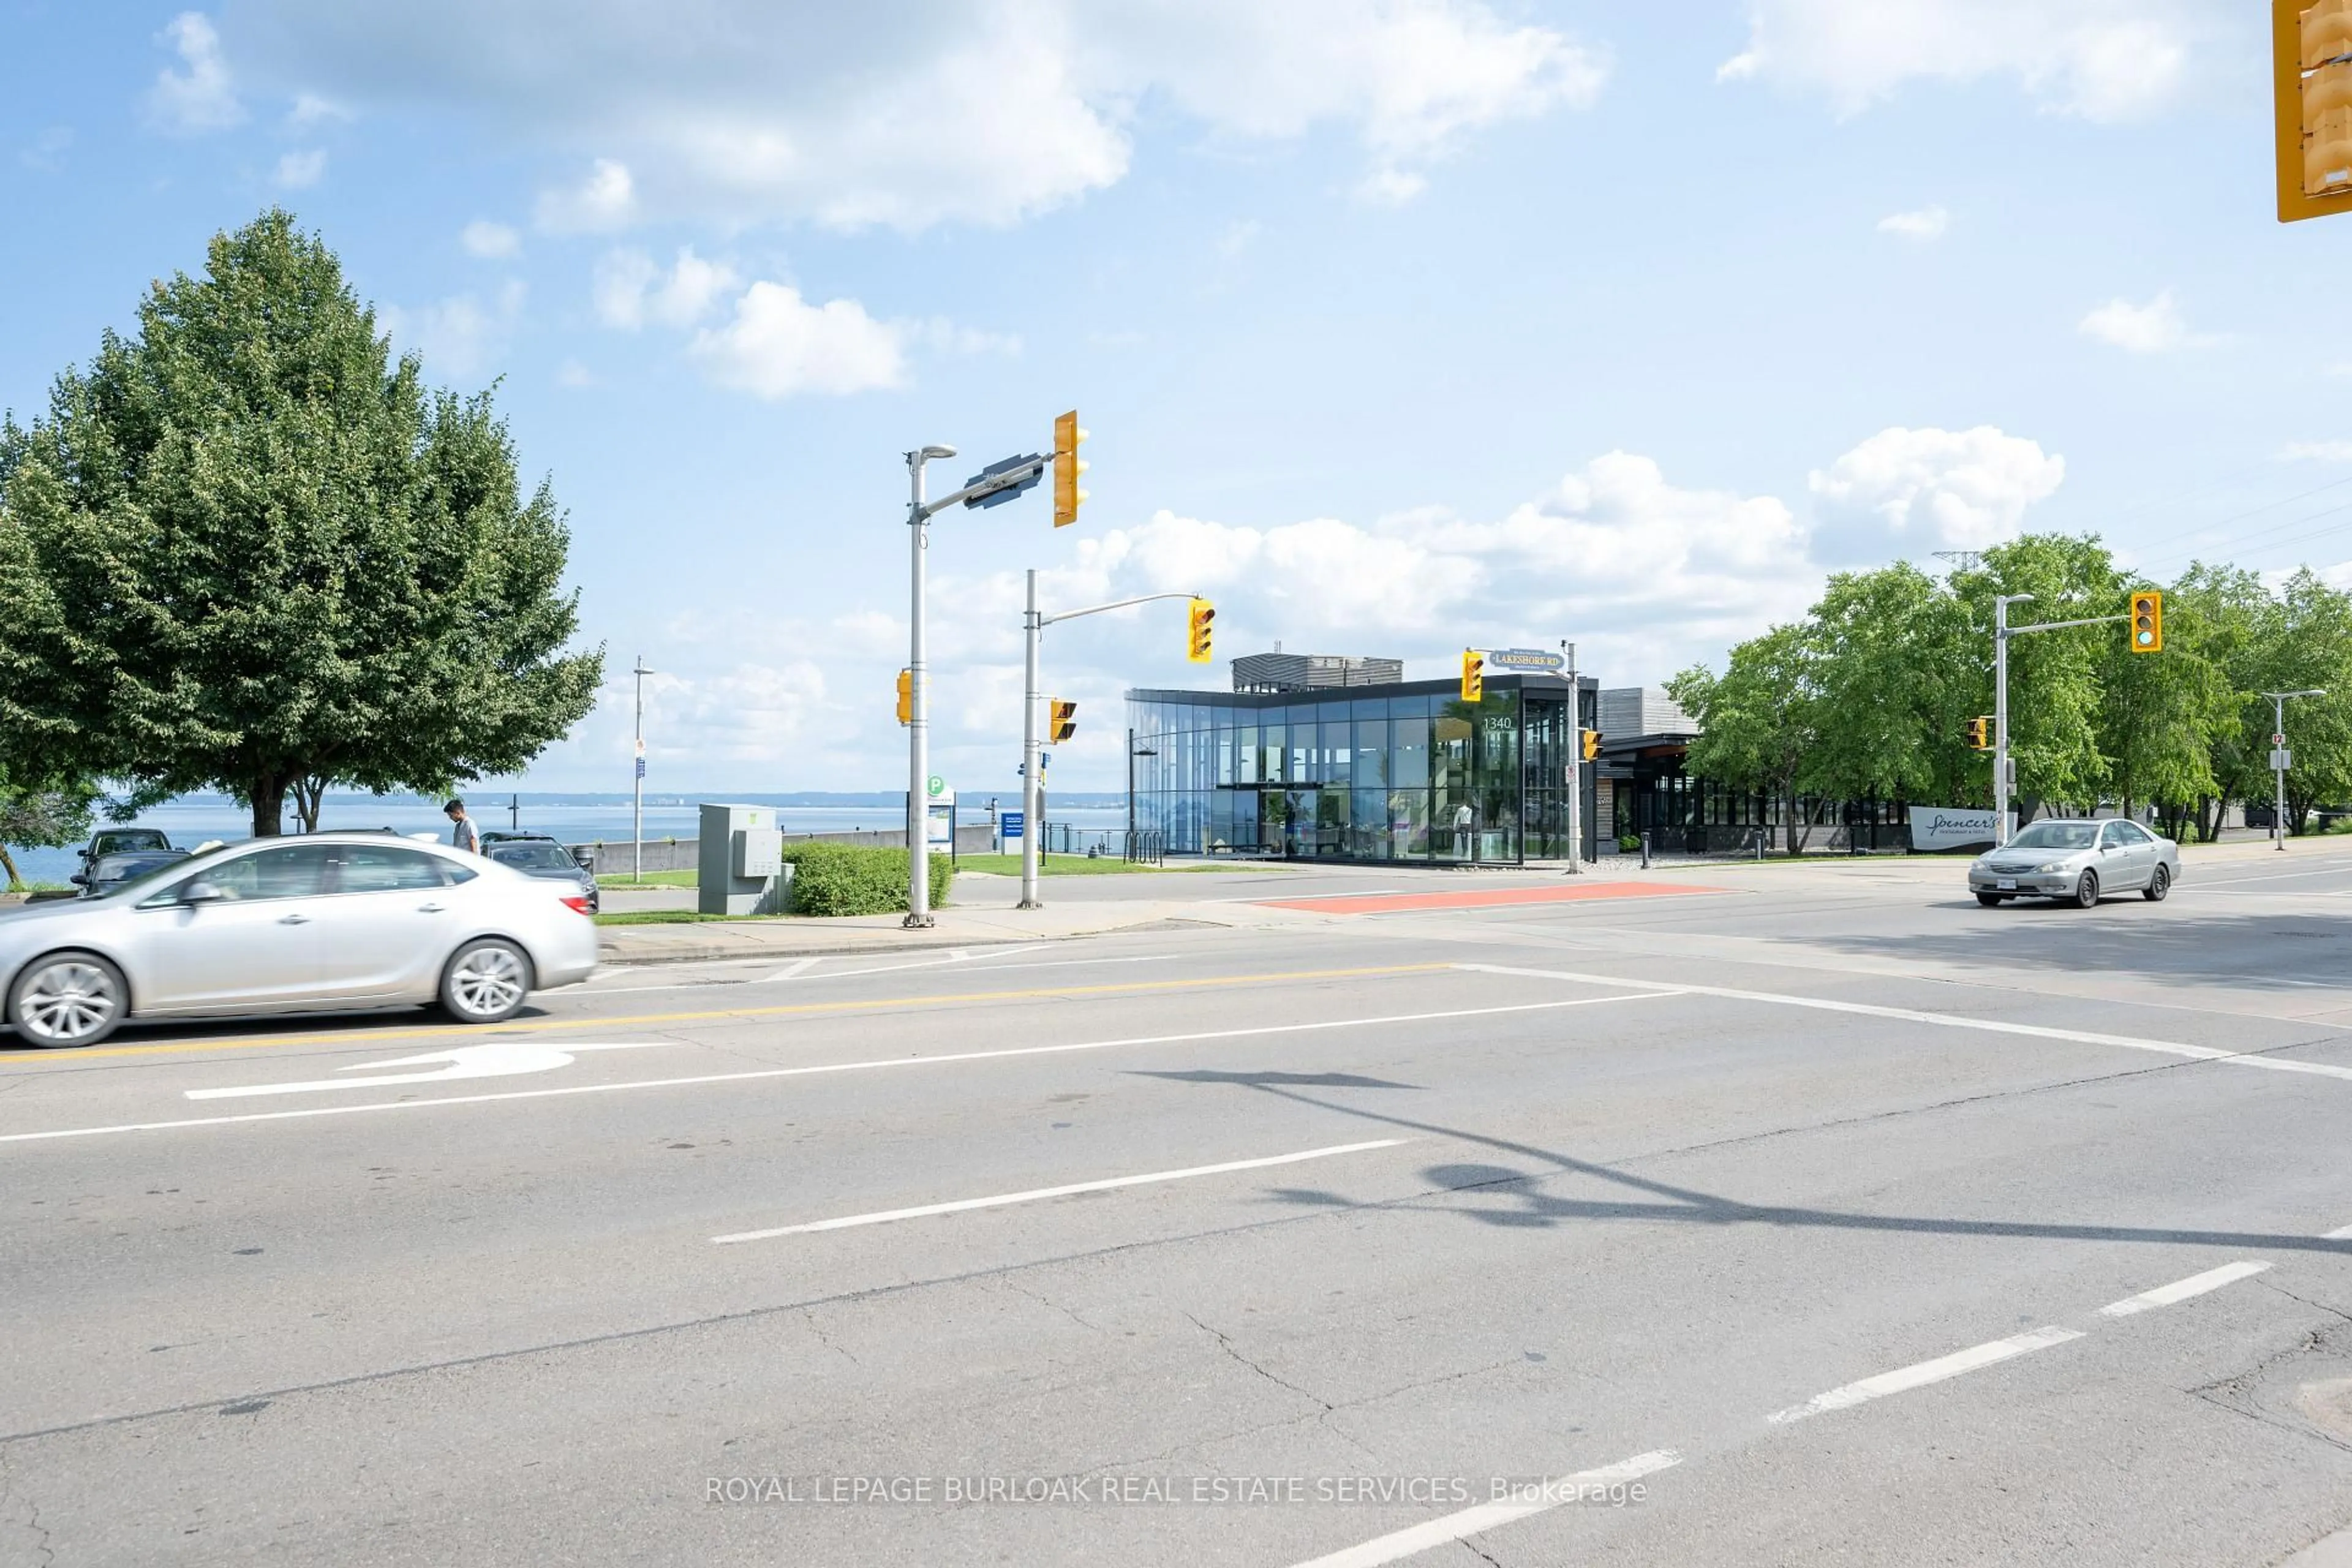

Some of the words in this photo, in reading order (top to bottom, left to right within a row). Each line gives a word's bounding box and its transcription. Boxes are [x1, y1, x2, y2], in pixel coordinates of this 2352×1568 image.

[1495, 654, 1545, 665] LAKESHORE
[1547, 657, 1558, 666] RD
[1484, 717, 1512, 729] 1340
[932, 778, 941, 791] P
[1926, 814, 1997, 836] Spencer's
